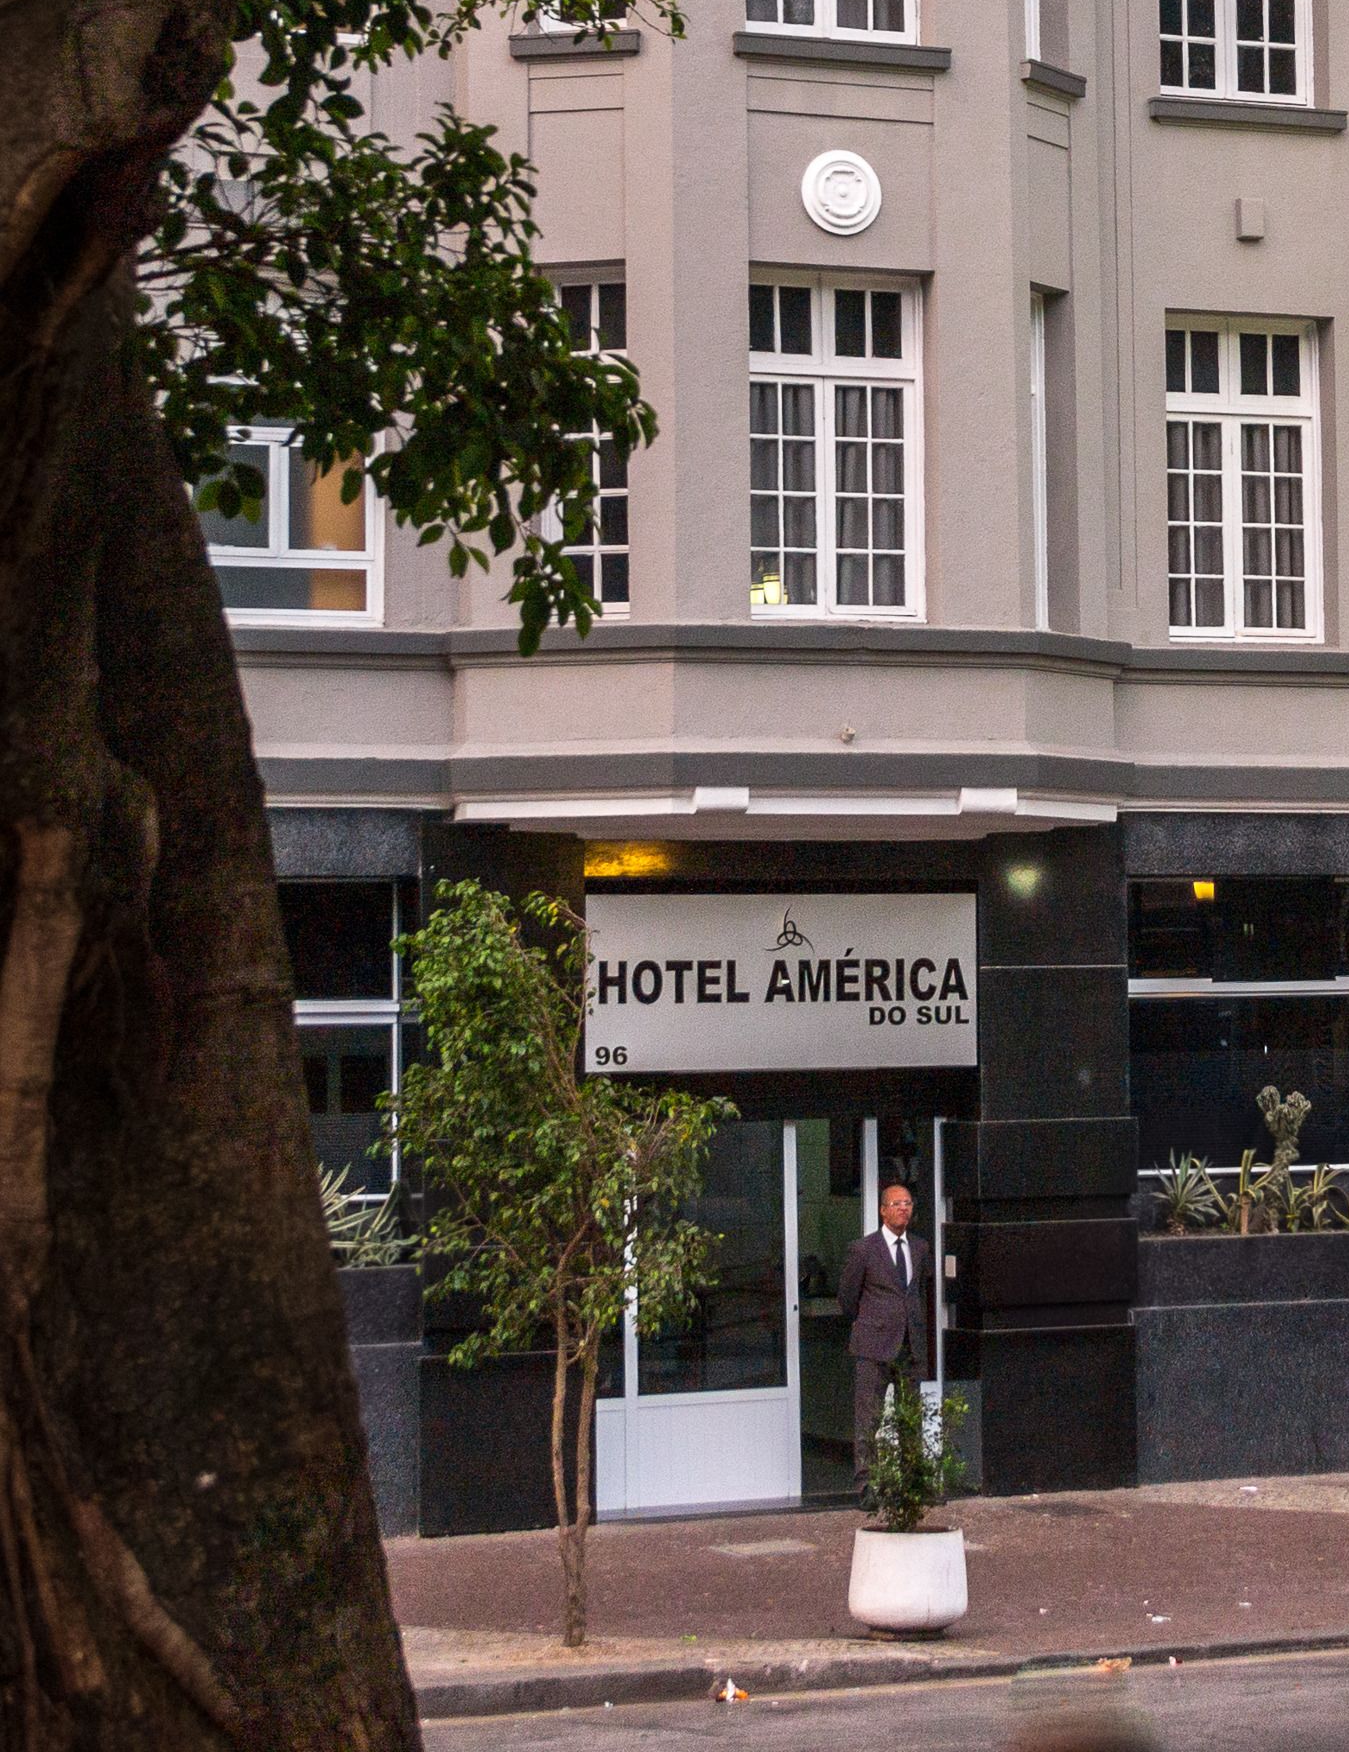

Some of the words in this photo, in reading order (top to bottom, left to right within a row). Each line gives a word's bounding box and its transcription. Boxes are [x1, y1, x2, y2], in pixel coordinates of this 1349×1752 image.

[598, 959, 751, 1005] HOTEL
[764, 948, 969, 1003] AMÉRICA
[868, 1005, 907, 1026] DO
[916, 1005, 970, 1025] SUL
[595, 1046, 628, 1066] 96
